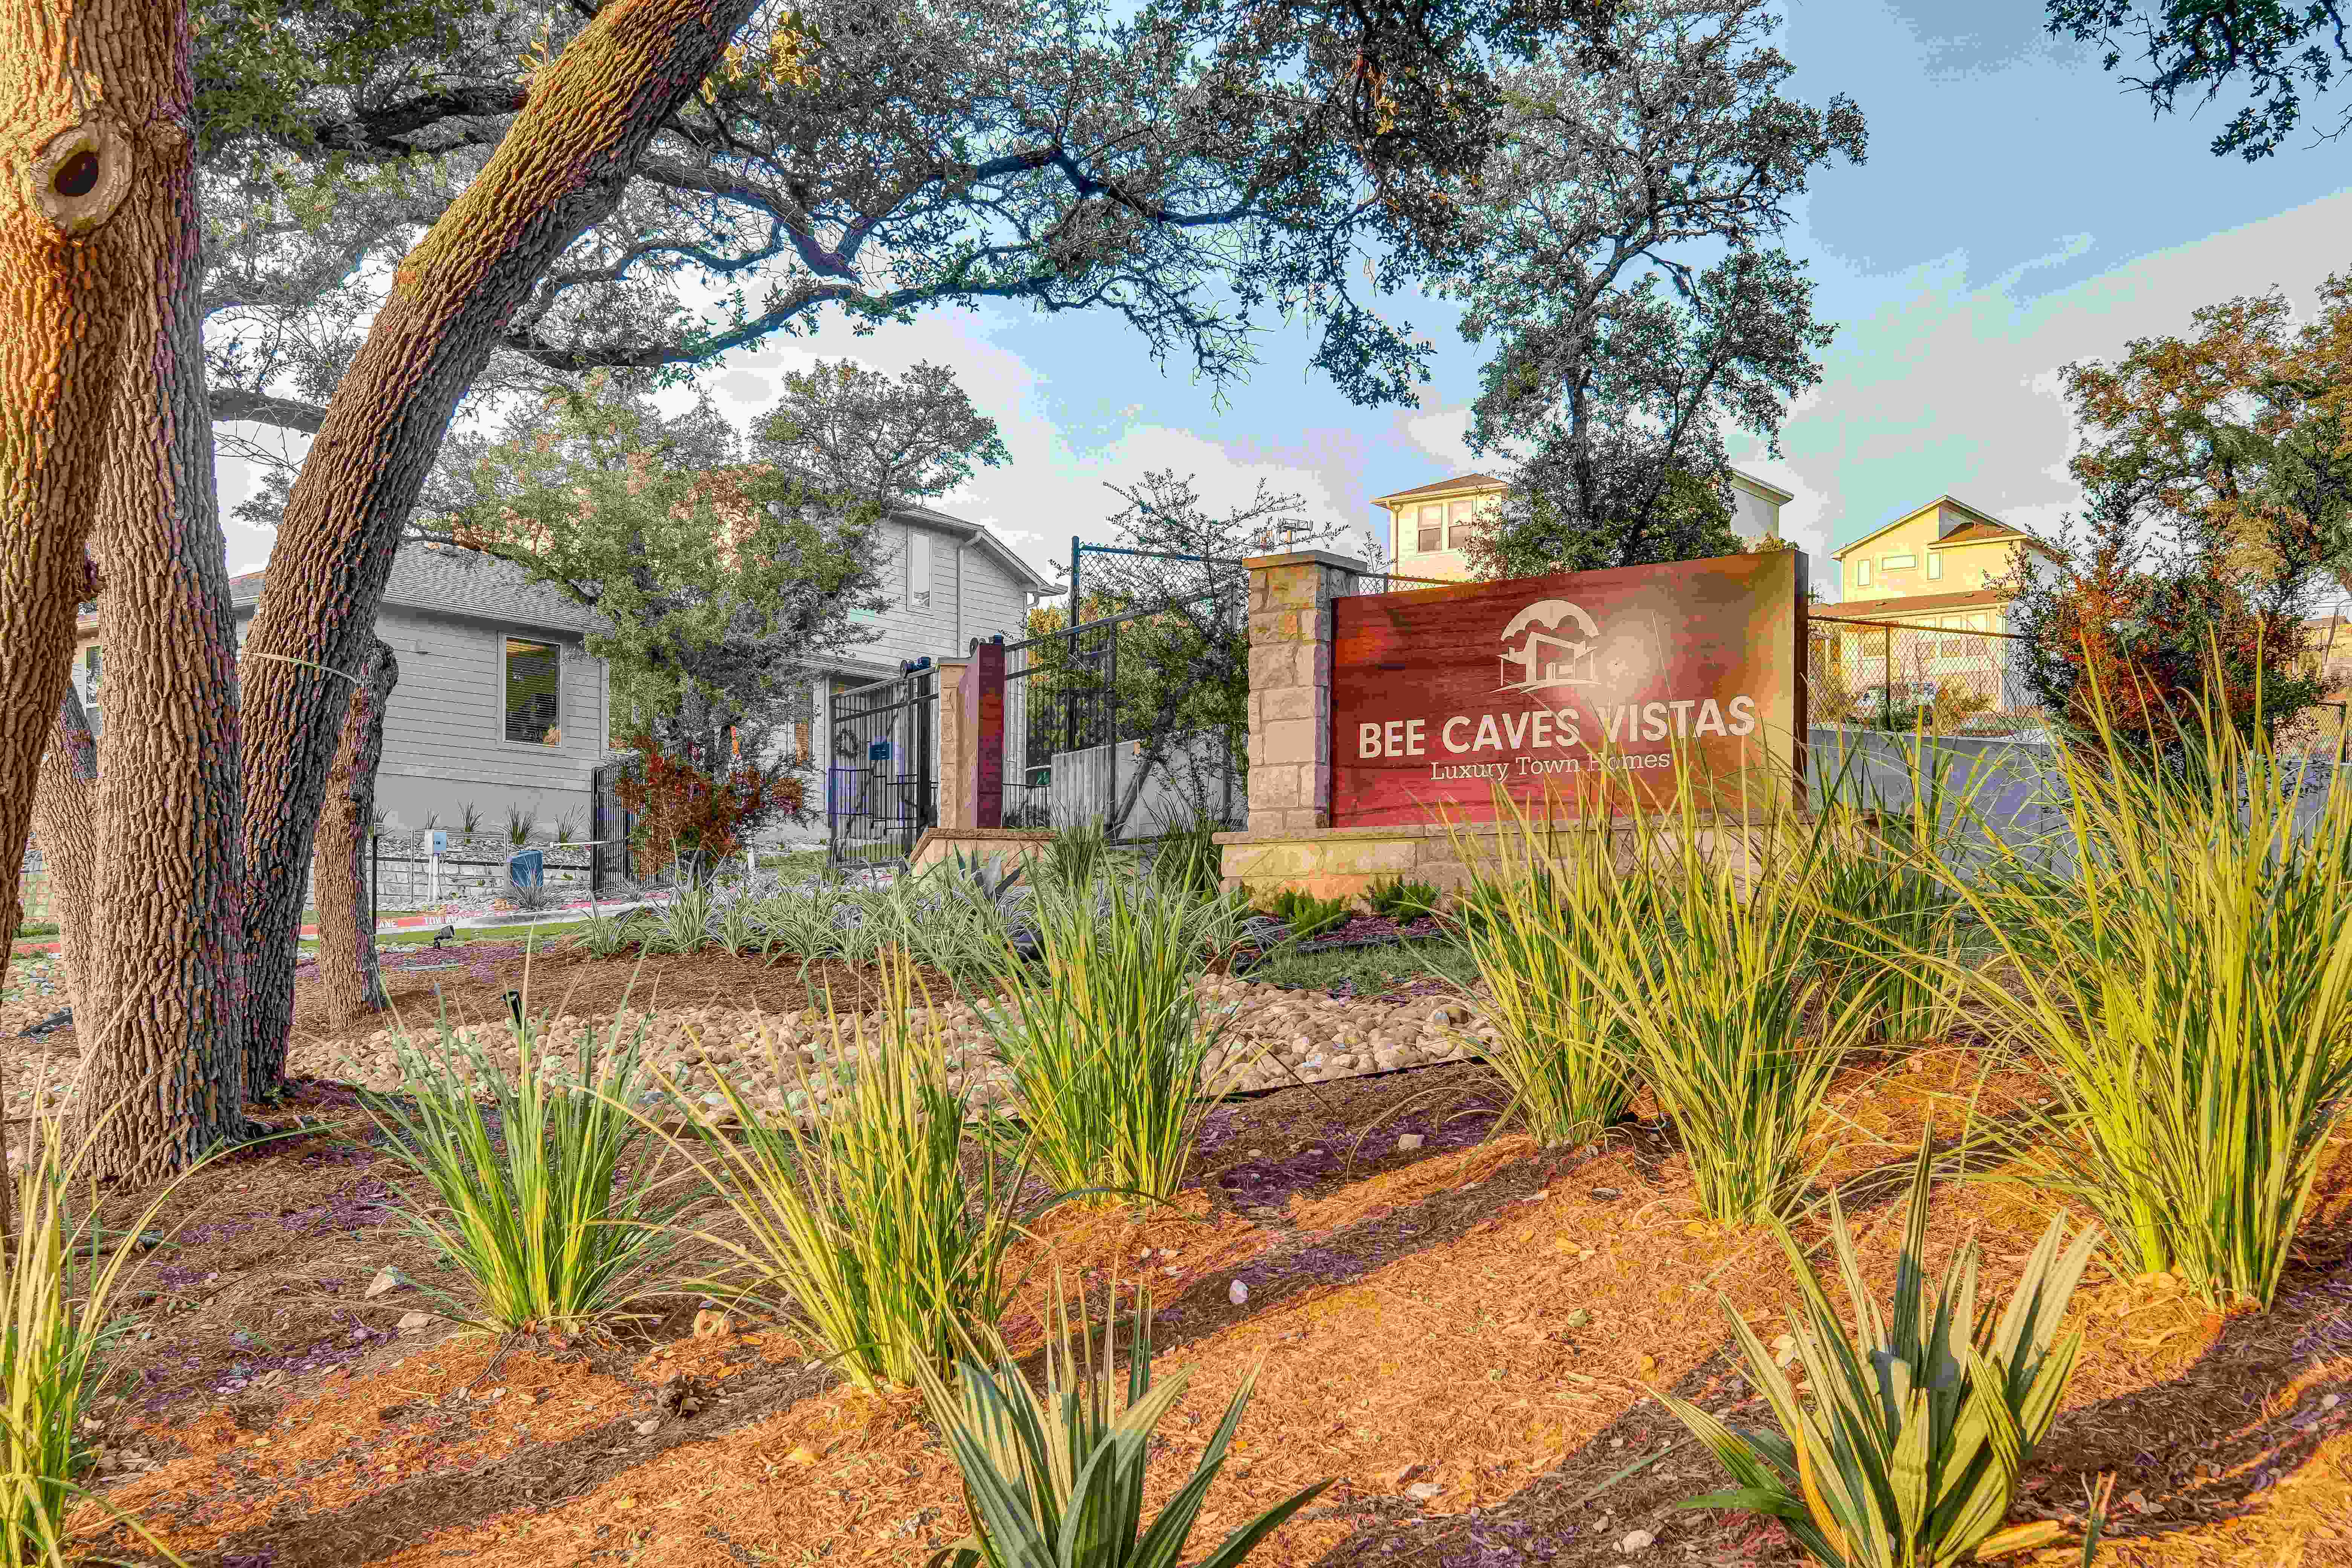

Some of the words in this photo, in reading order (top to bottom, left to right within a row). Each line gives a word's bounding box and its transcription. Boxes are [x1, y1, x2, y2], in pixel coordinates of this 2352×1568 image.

[1359, 719, 1425, 758] BEE
[1442, 709, 1580, 753] CAVES
[1597, 696, 1755, 743] VISTAS
[1430, 761, 1509, 781] Luxury
[1515, 756, 1580, 775] Town
[1586, 753, 1670, 772] Homes
